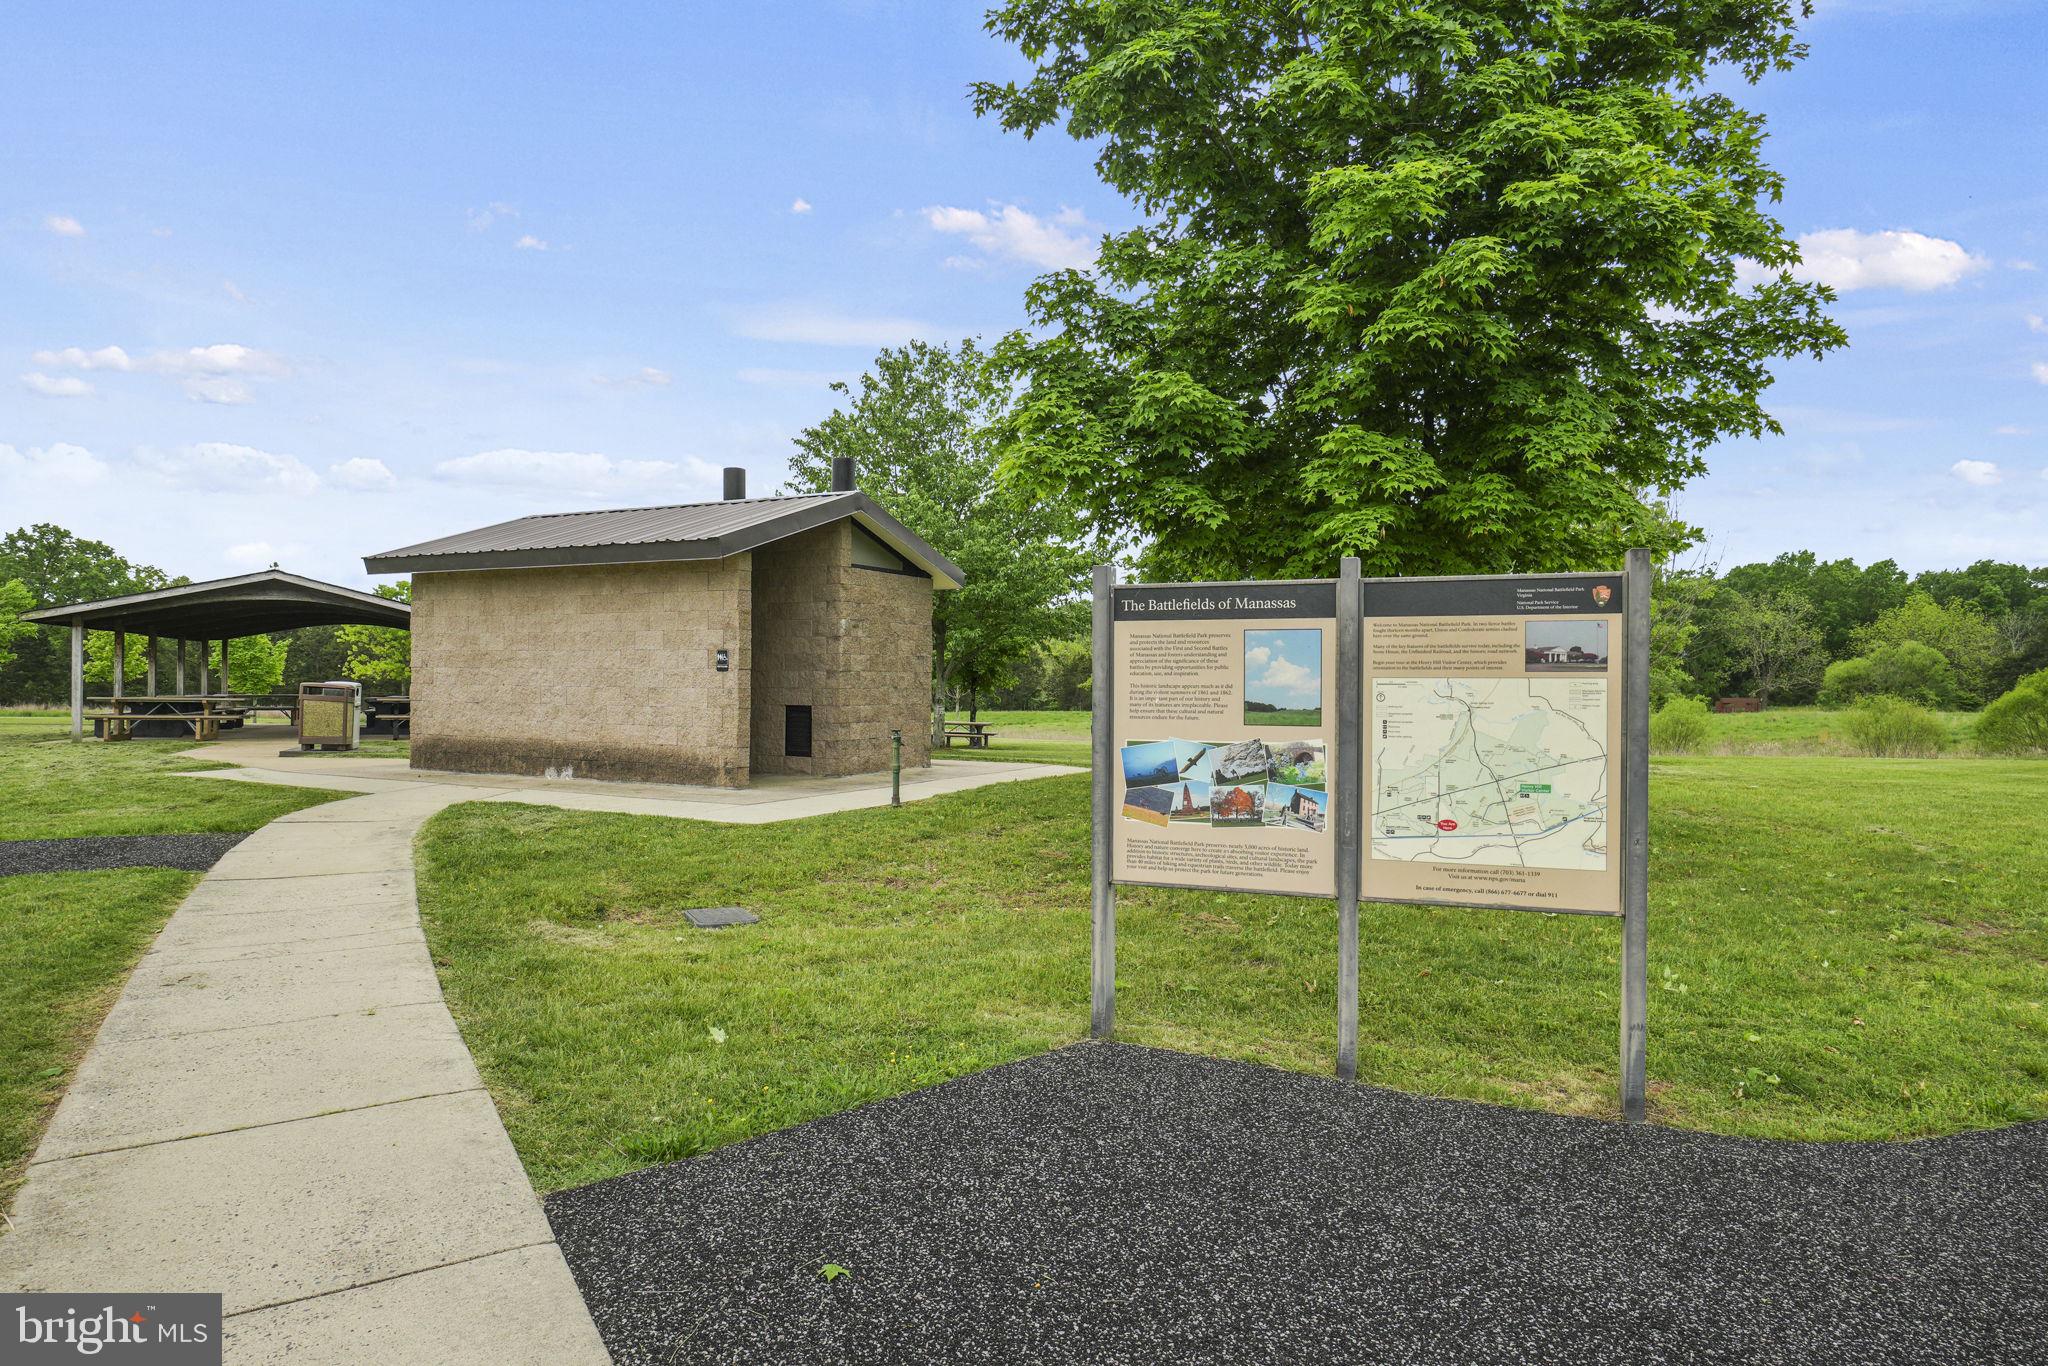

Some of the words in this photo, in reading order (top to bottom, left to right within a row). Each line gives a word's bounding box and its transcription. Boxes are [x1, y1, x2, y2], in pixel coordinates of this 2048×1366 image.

[1121, 600, 1145, 611] The
[1148, 599, 1215, 611] Battlefields
[1218, 598, 1232, 610] of
[1234, 598, 1296, 610] Manassas
